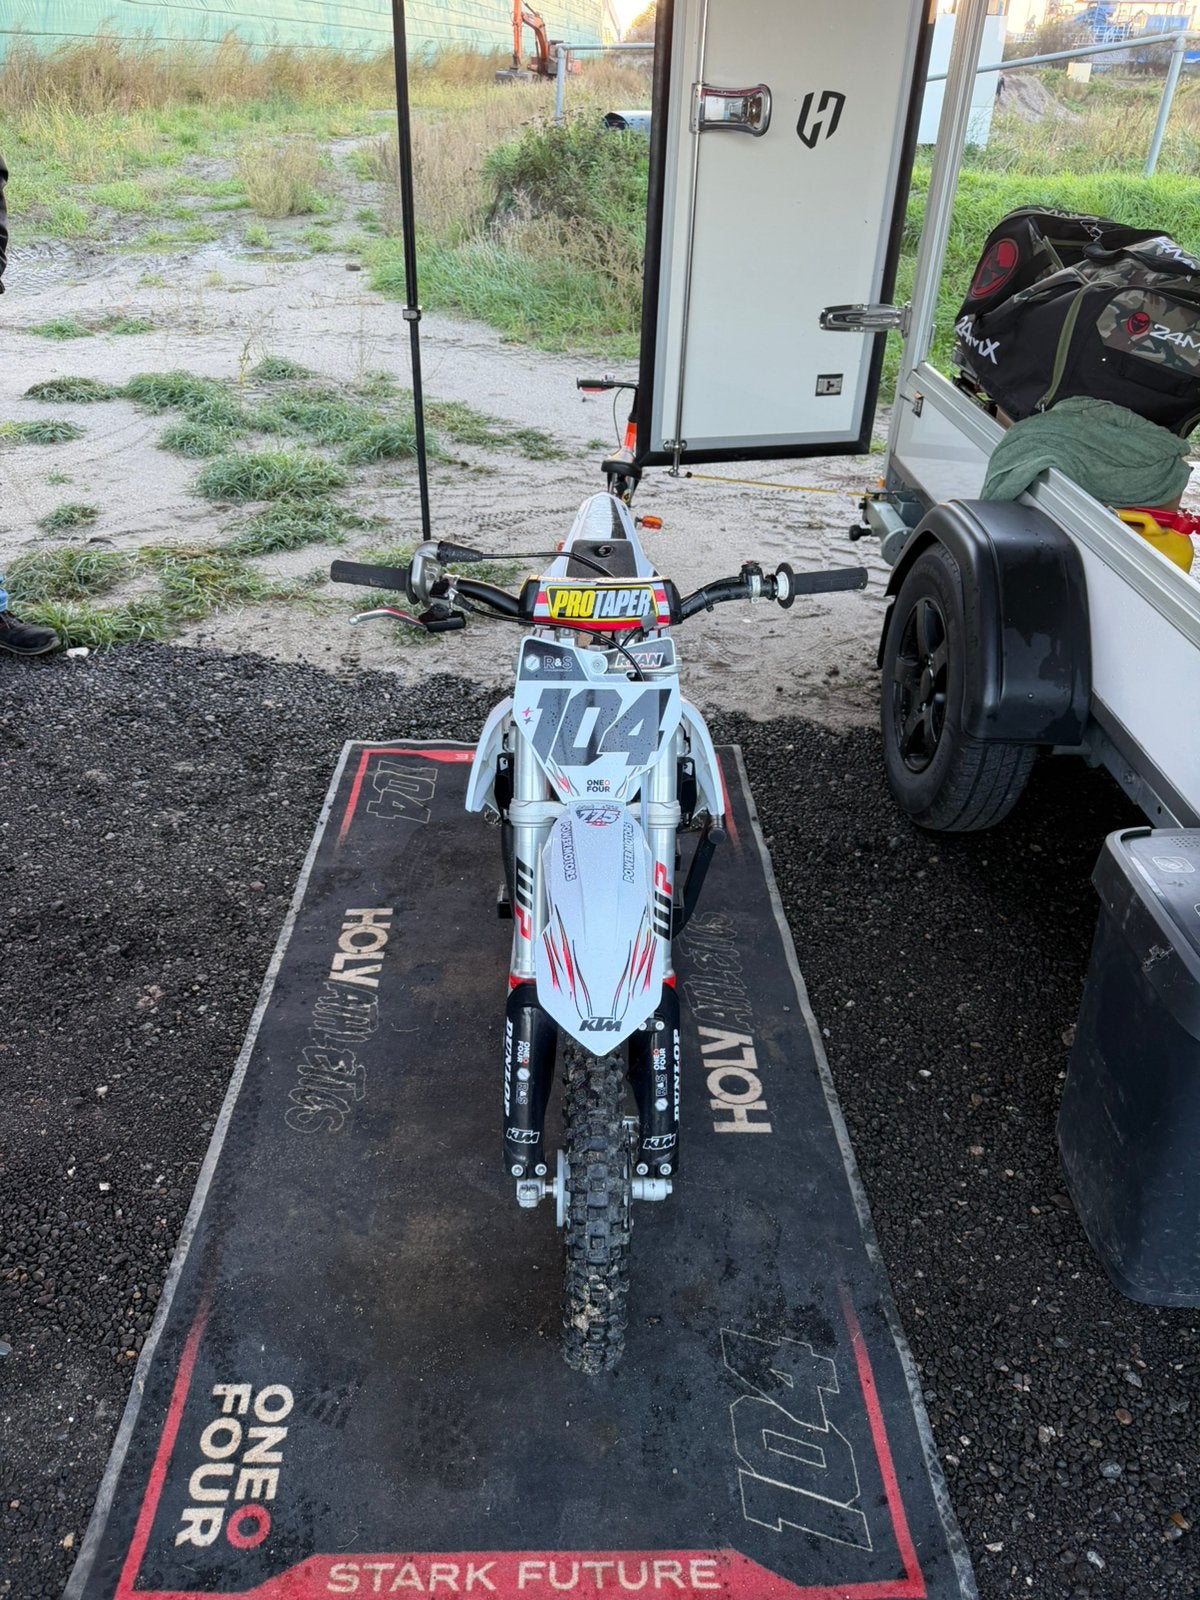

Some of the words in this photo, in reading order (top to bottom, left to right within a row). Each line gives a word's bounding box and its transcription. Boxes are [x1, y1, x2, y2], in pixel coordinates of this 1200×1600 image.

[551, 589, 651, 619] PROTAPER
[543, 655, 573, 669] R&S
[531, 688, 672, 766] 104
[329, 907, 394, 988] HOLY
[516, 1040, 524, 1063] FOUR
[578, 1016, 623, 1032] KTM
[504, 1016, 514, 1118] DUNLOP
[673, 1028, 681, 1121] DUNLOP
[697, 1025, 773, 1134] HOLY
[506, 1127, 540, 1144] KTM
[643, 1133, 676, 1150] KTM
[174, 1384, 252, 1548] FOUR
[720, 1327, 873, 1552] 104
[327, 1562, 497, 1592] STARK
[517, 1559, 721, 1590] FUTURE
